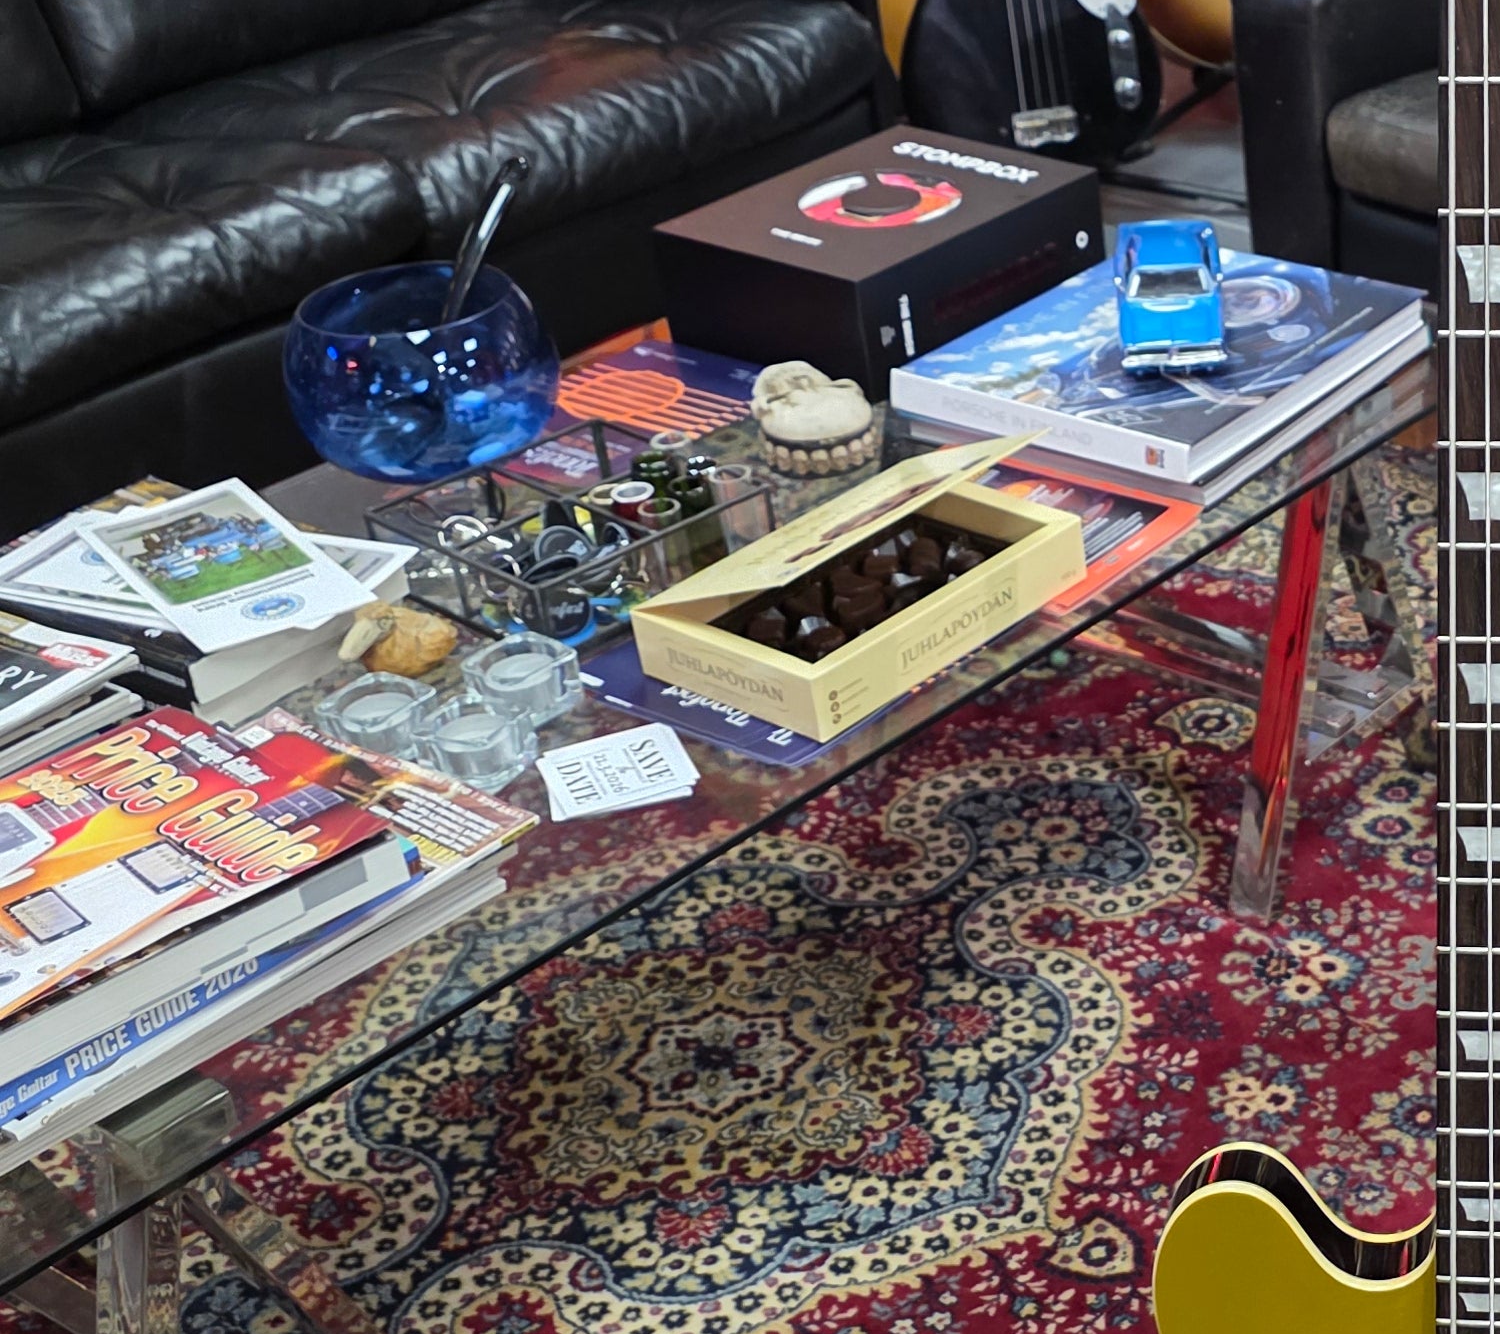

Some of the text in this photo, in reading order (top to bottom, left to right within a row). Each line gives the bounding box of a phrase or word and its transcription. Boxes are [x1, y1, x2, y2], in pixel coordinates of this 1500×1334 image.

[556, 761, 602, 805] DATE
[628, 738, 675, 783] SAVE
[51, 726, 199, 814] Price
[158, 788, 321, 882] Guide
[17, 1068, 60, 1103] Guitar
[64, 1024, 132, 1080] PRICE
[135, 988, 200, 1038] GUIDE
